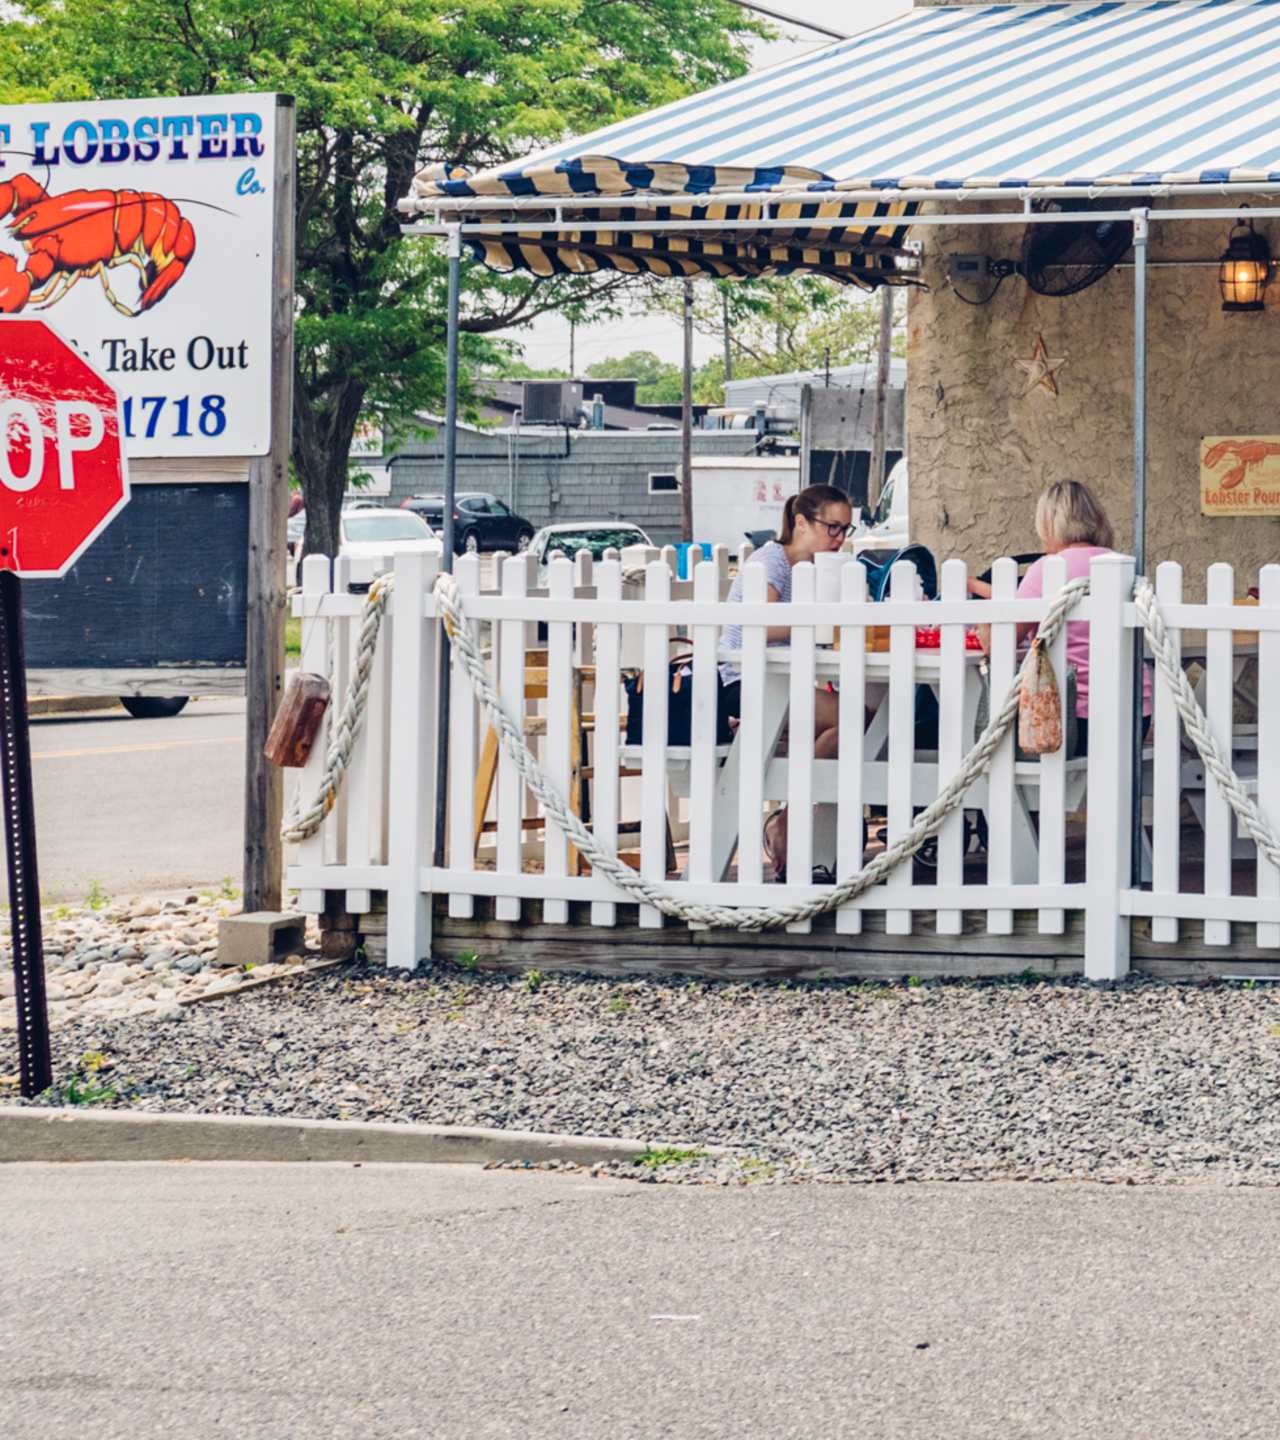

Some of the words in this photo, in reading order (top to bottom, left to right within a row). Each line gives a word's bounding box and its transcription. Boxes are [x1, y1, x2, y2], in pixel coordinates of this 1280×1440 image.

[30, 112, 265, 166] LOBSTER
[235, 167, 265, 196] Co.
[101, 336, 176, 372] Take
[187, 335, 249, 371] Out
[1205, 487, 1250, 506] Lobster
